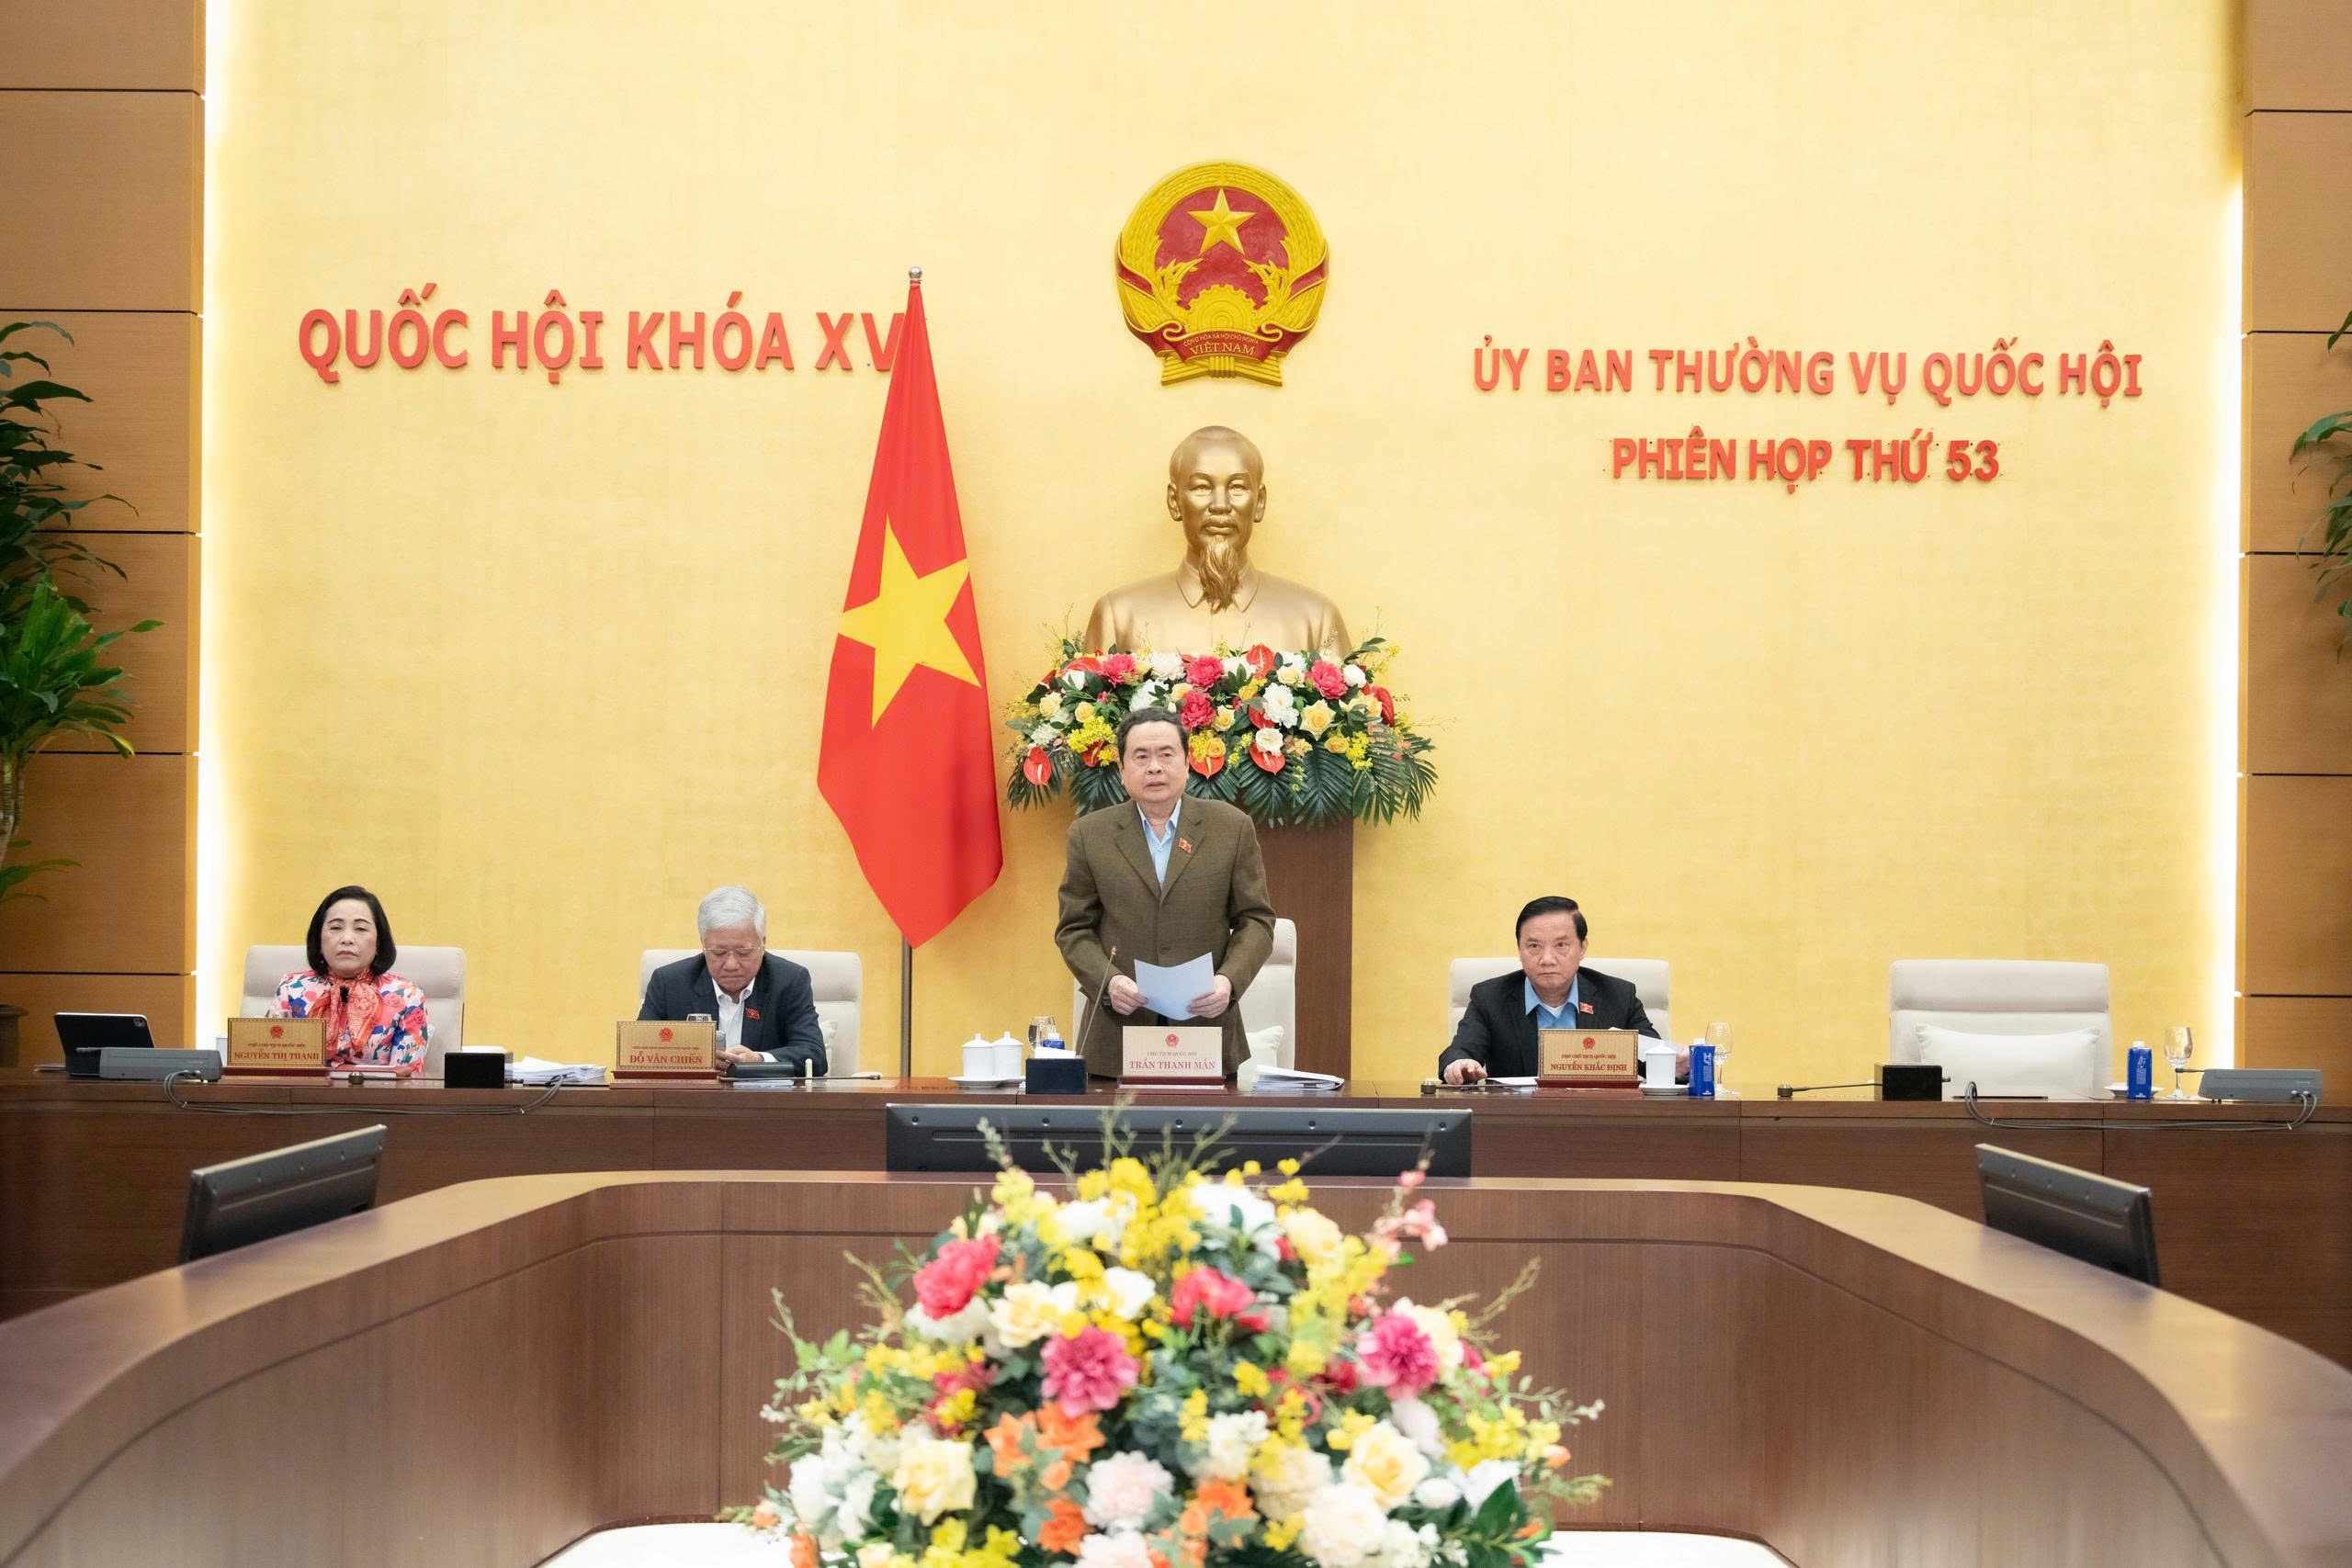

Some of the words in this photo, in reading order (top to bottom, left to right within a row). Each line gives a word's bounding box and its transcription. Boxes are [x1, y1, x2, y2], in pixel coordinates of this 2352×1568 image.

[299, 282, 469, 383] QUỐC
[492, 289, 604, 384] HỘI
[628, 291, 795, 371] KHÓA
[815, 312, 904, 371] XV
[1222, 343, 1254, 355] NAM
[1474, 334, 1530, 392] ỦY
[1546, 348, 1633, 393] BAN
[1648, 336, 1835, 395] THƯỜNG
[1849, 352, 1906, 405] VỤ
[1922, 337, 2044, 406] QUỐC
[2059, 340, 2143, 408] HỘI
[1612, 425, 1737, 480] PHIÊN
[1748, 438, 1833, 494] HỌP
[1845, 428, 1934, 483] THỨ
[1946, 439, 2000, 482] 53
[234, 1048, 270, 1059] NGUYỄN
[272, 1052, 287, 1061] THỊ
[288, 1052, 320, 1060] THANH
[629, 1050, 645, 1064] ĐỖ
[670, 1053, 703, 1064] CHIẾN
[1550, 1060, 1583, 1071] NGUYỄN
[1584, 1060, 1606, 1071] KHẮC
[1607, 1064, 1627, 1072] ĐỊNH
